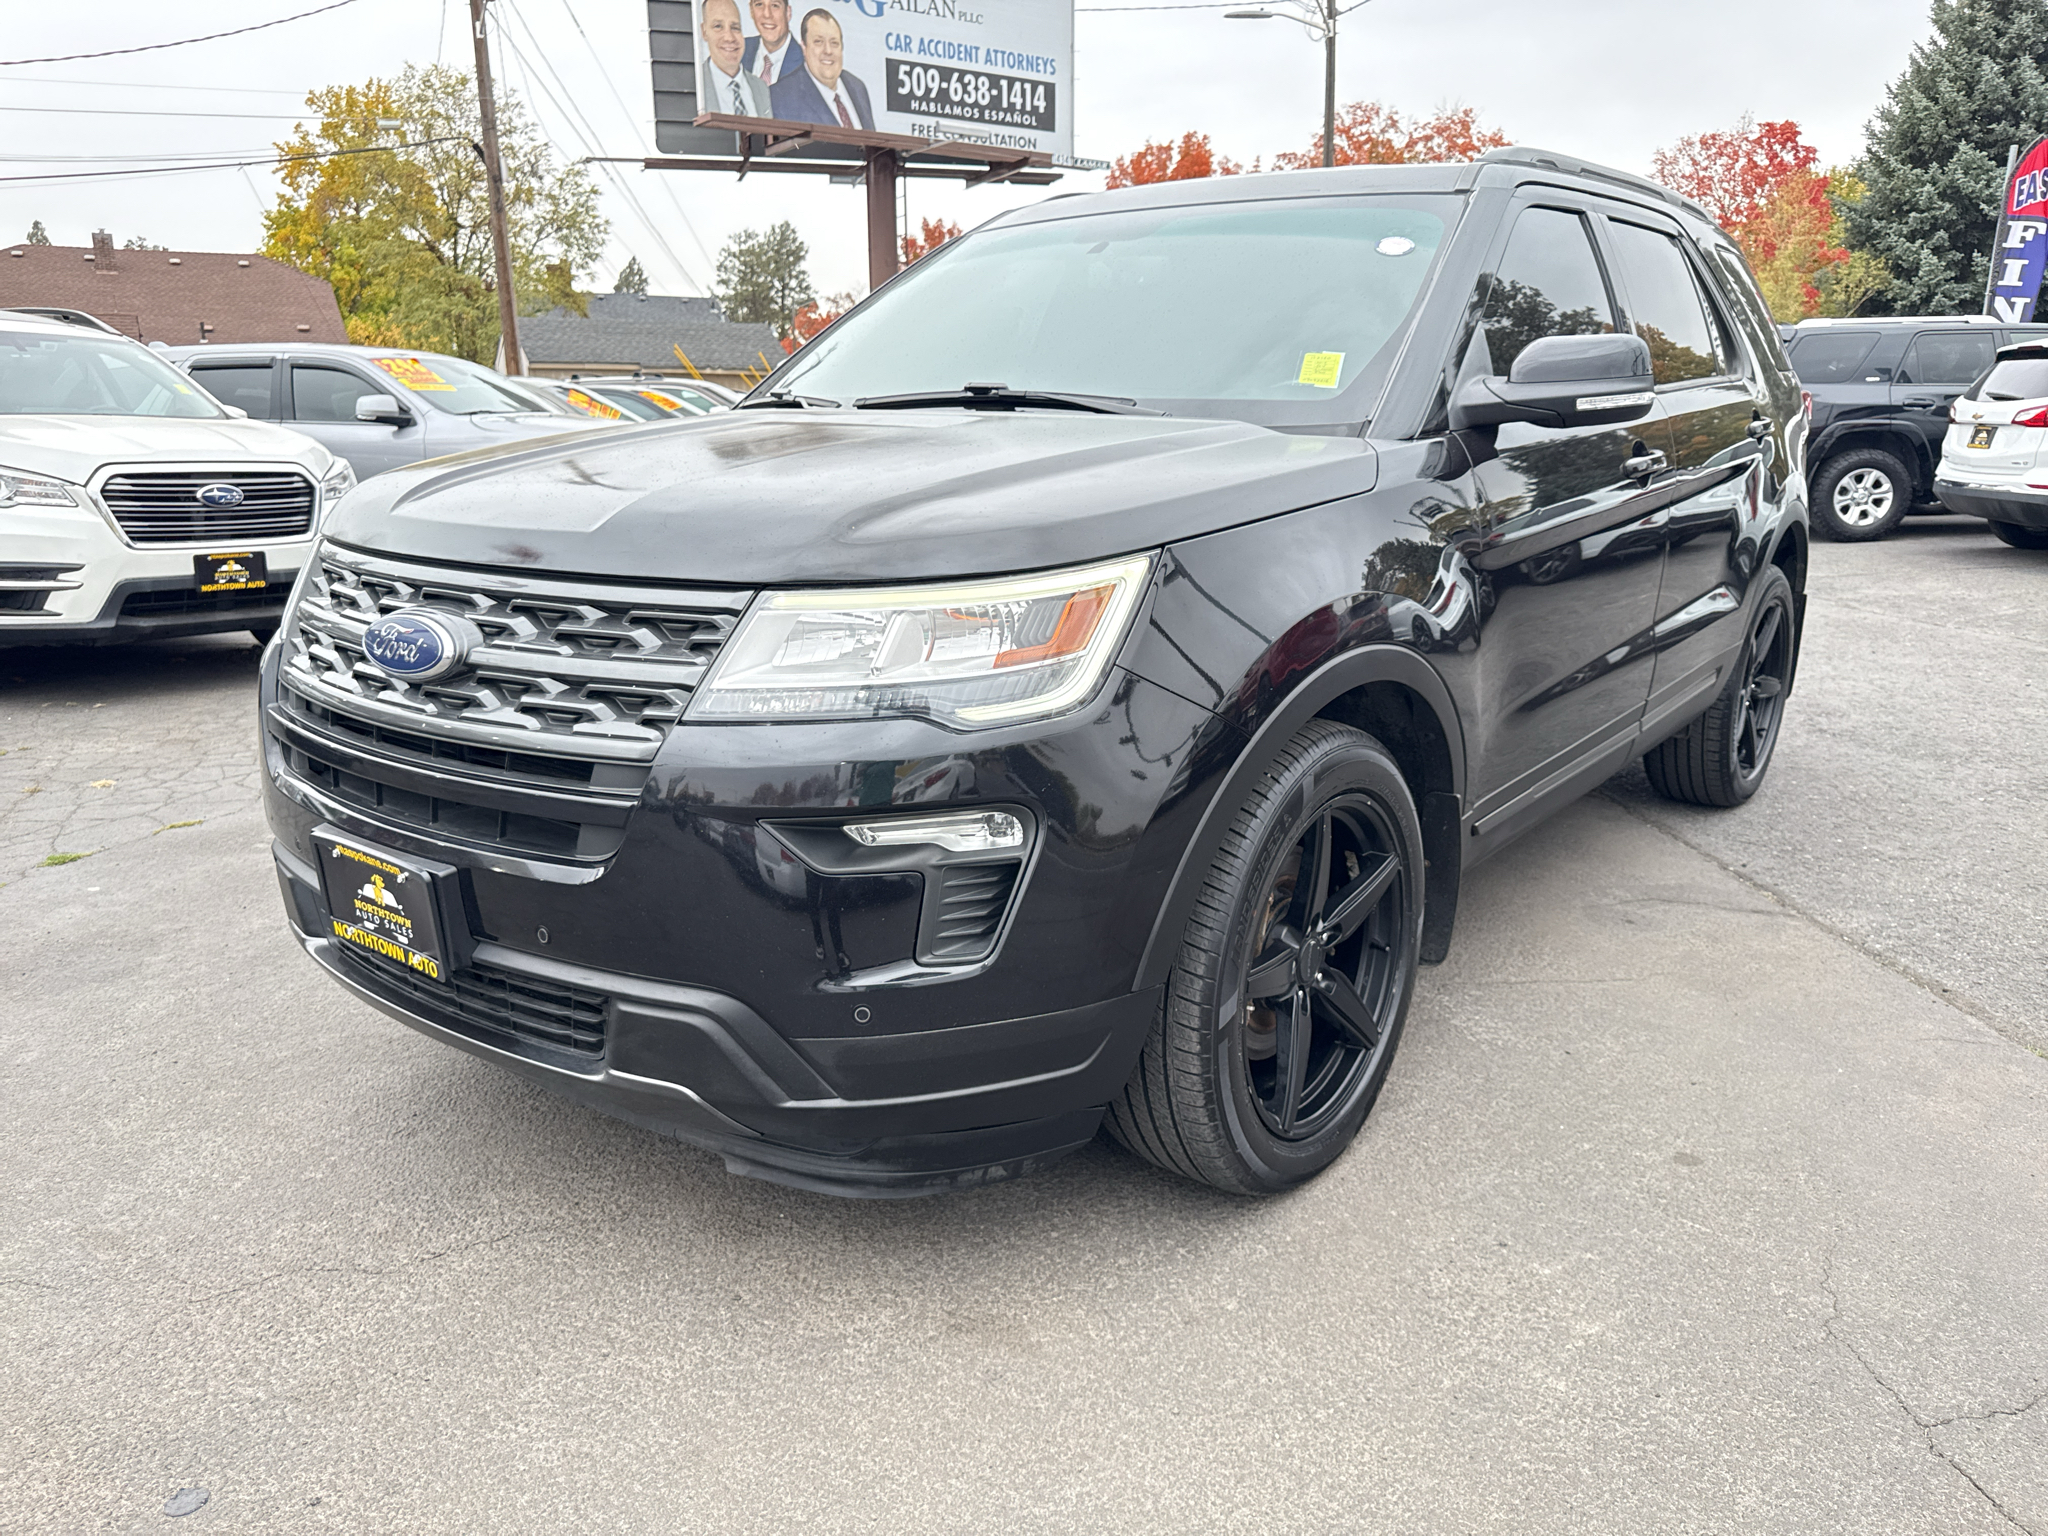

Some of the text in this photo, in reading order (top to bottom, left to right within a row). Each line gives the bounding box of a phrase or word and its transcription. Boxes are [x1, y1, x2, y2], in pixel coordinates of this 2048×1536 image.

[958, 11, 984, 25] PLLC
[885, 32, 1056, 75] CAR ACCIDENT ATTORNEYS
[897, 64, 1046, 113] 509-638-1414
[911, 99, 1037, 126] HABLAMOS ESPAÑOL
[201, 580, 266, 592] NORTHTOWN AUTO
[372, 622, 424, 663] Ford
[354, 899, 412, 928] NORTHTOWN
[356, 909, 413, 938] AUTO SALES
[333, 921, 438, 978] NORTHTOWN AUTO
